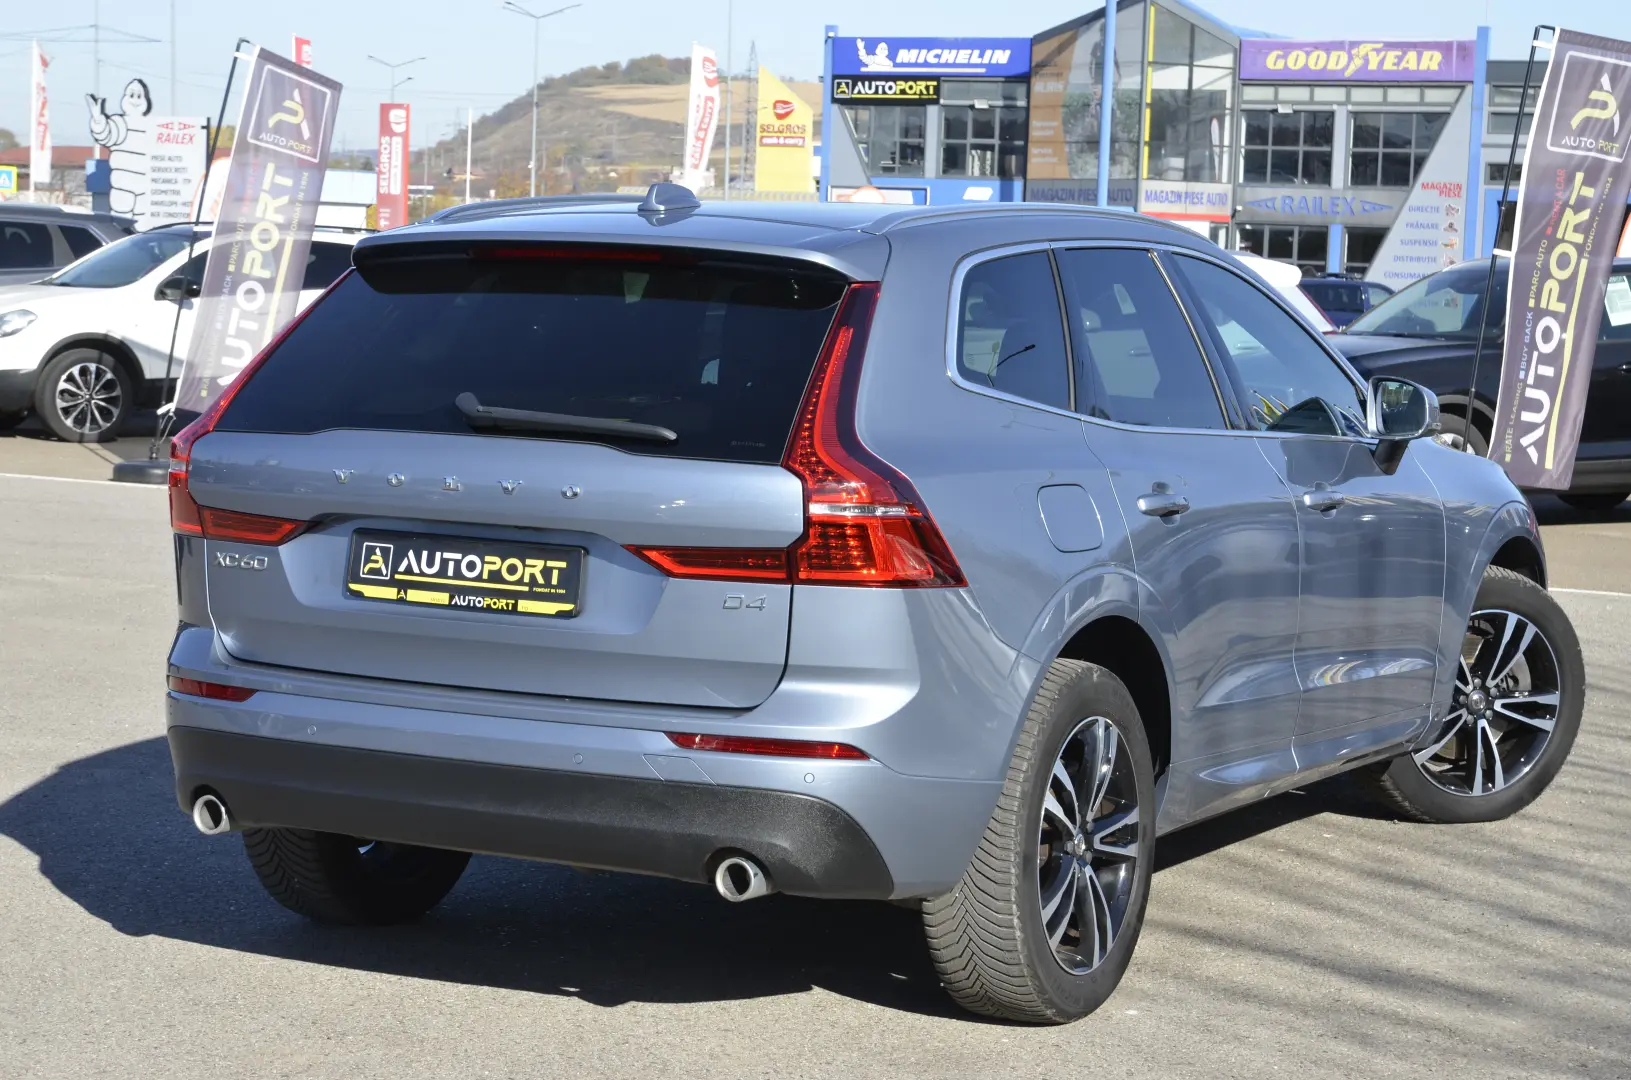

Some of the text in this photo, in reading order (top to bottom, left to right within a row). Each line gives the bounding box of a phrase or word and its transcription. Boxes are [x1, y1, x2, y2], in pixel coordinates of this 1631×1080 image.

[896, 49, 1011, 64] MICHELIN
[853, 81, 937, 95] AUTOPORT
[760, 124, 806, 134] SELGROS
[156, 133, 195, 145] RAILEX
[259, 132, 313, 154] AUTO PORT
[1561, 135, 1619, 154] AUTO PORT
[380, 136, 391, 194] SELGROS
[1030, 188, 1133, 202] MAGAZIN PIES AUTO
[1421, 182, 1462, 191] MAGAZIN
[1439, 190, 1462, 198] PIESE
[1144, 189, 1228, 206] MAGAZIN PIESE AUTO
[1281, 195, 1356, 216] RAILEX
[229, 242, 239, 264] PARC
[235, 216, 246, 240] AUTO
[1583, 215, 1600, 259] FONDAT
[1505, 427, 1514, 454] RATE
[1511, 382, 1523, 425] LEASING
[1519, 345, 1528, 369] BUY
[1525, 311, 1534, 344] BACK
[1530, 269, 1541, 297] PARC
[1537, 239, 1548, 268] AUTO
[1556, 168, 1566, 189] CAR
[1520, 171, 1595, 465] AUTOPORT
[333, 468, 581, 500] VOLVO
[215, 551, 268, 570] XC60
[398, 549, 567, 585] AUTOPORT
[451, 594, 515, 611] AUTOPORT
[723, 593, 767, 611] D4
